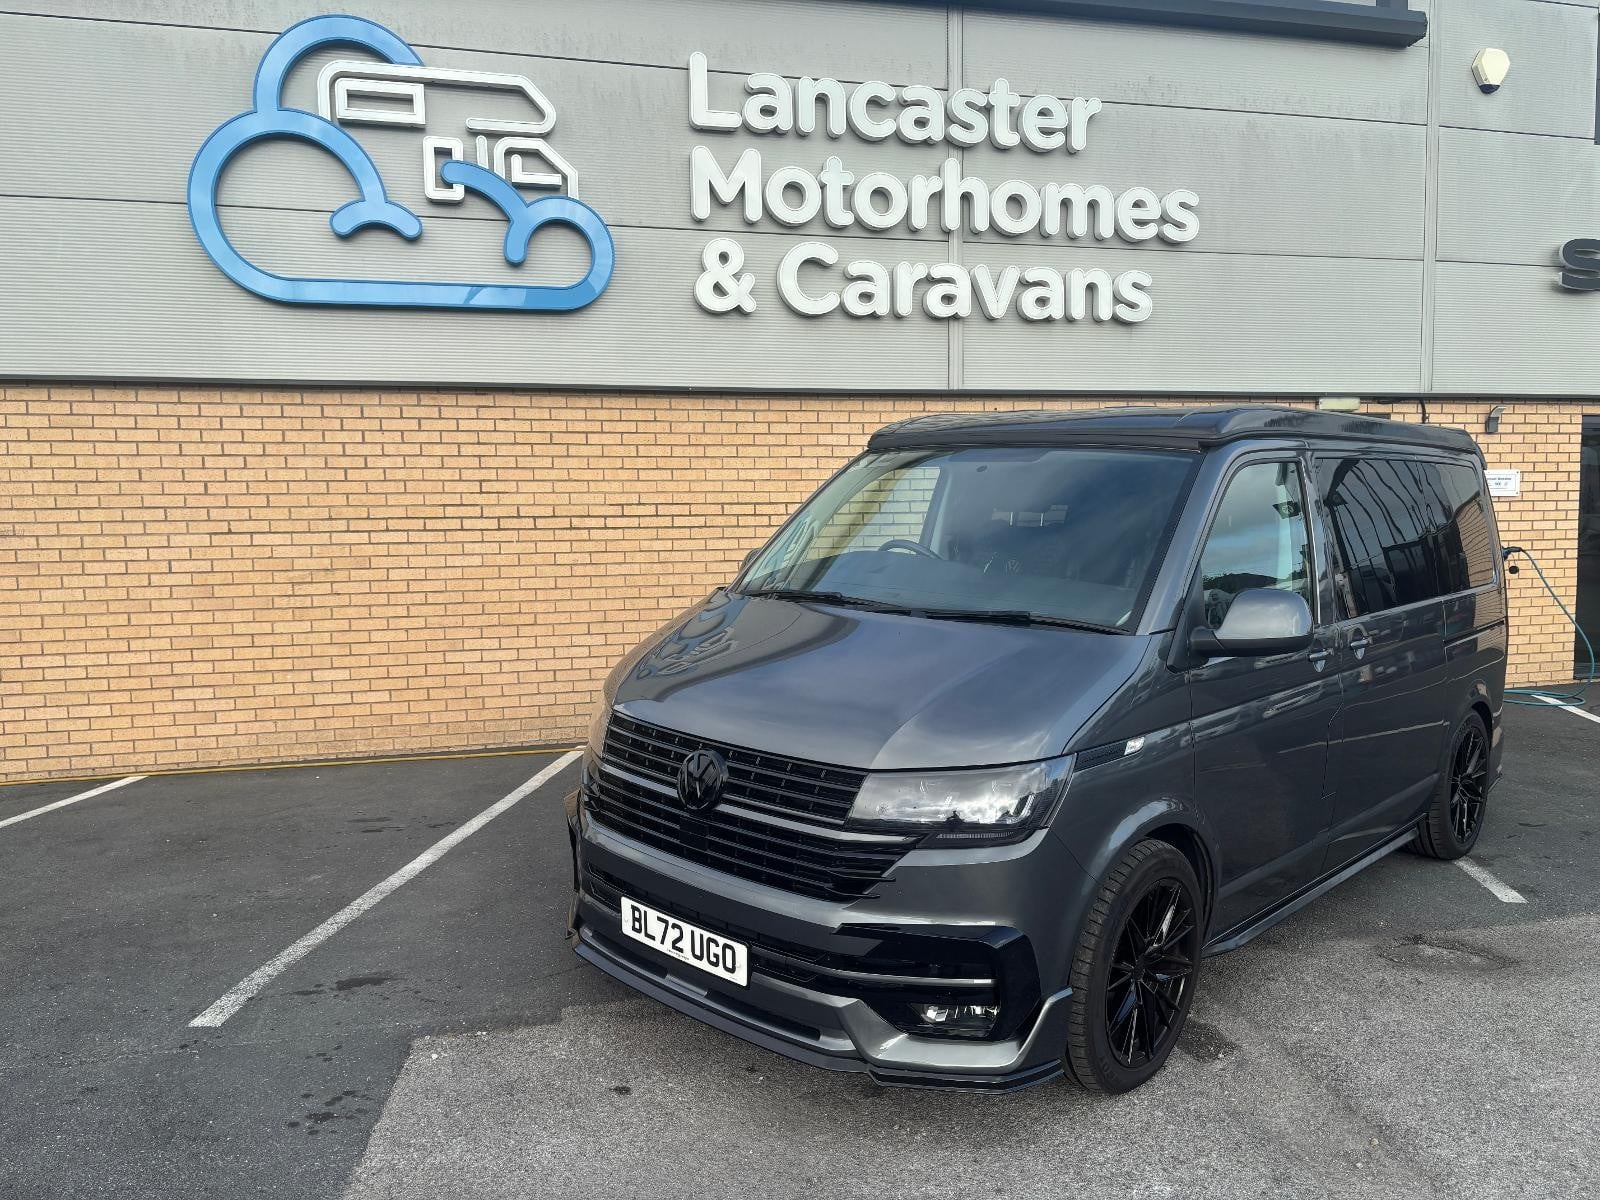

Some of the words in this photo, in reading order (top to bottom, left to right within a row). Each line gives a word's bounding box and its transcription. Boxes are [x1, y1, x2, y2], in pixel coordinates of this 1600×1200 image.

[688, 51, 1102, 153] Lancaster
[690, 145, 1200, 243] Motorhomes
[693, 237, 757, 314] &
[776, 240, 1153, 322] Caravans
[630, 904, 684, 954] BL72
[690, 929, 737, 974] UGO
